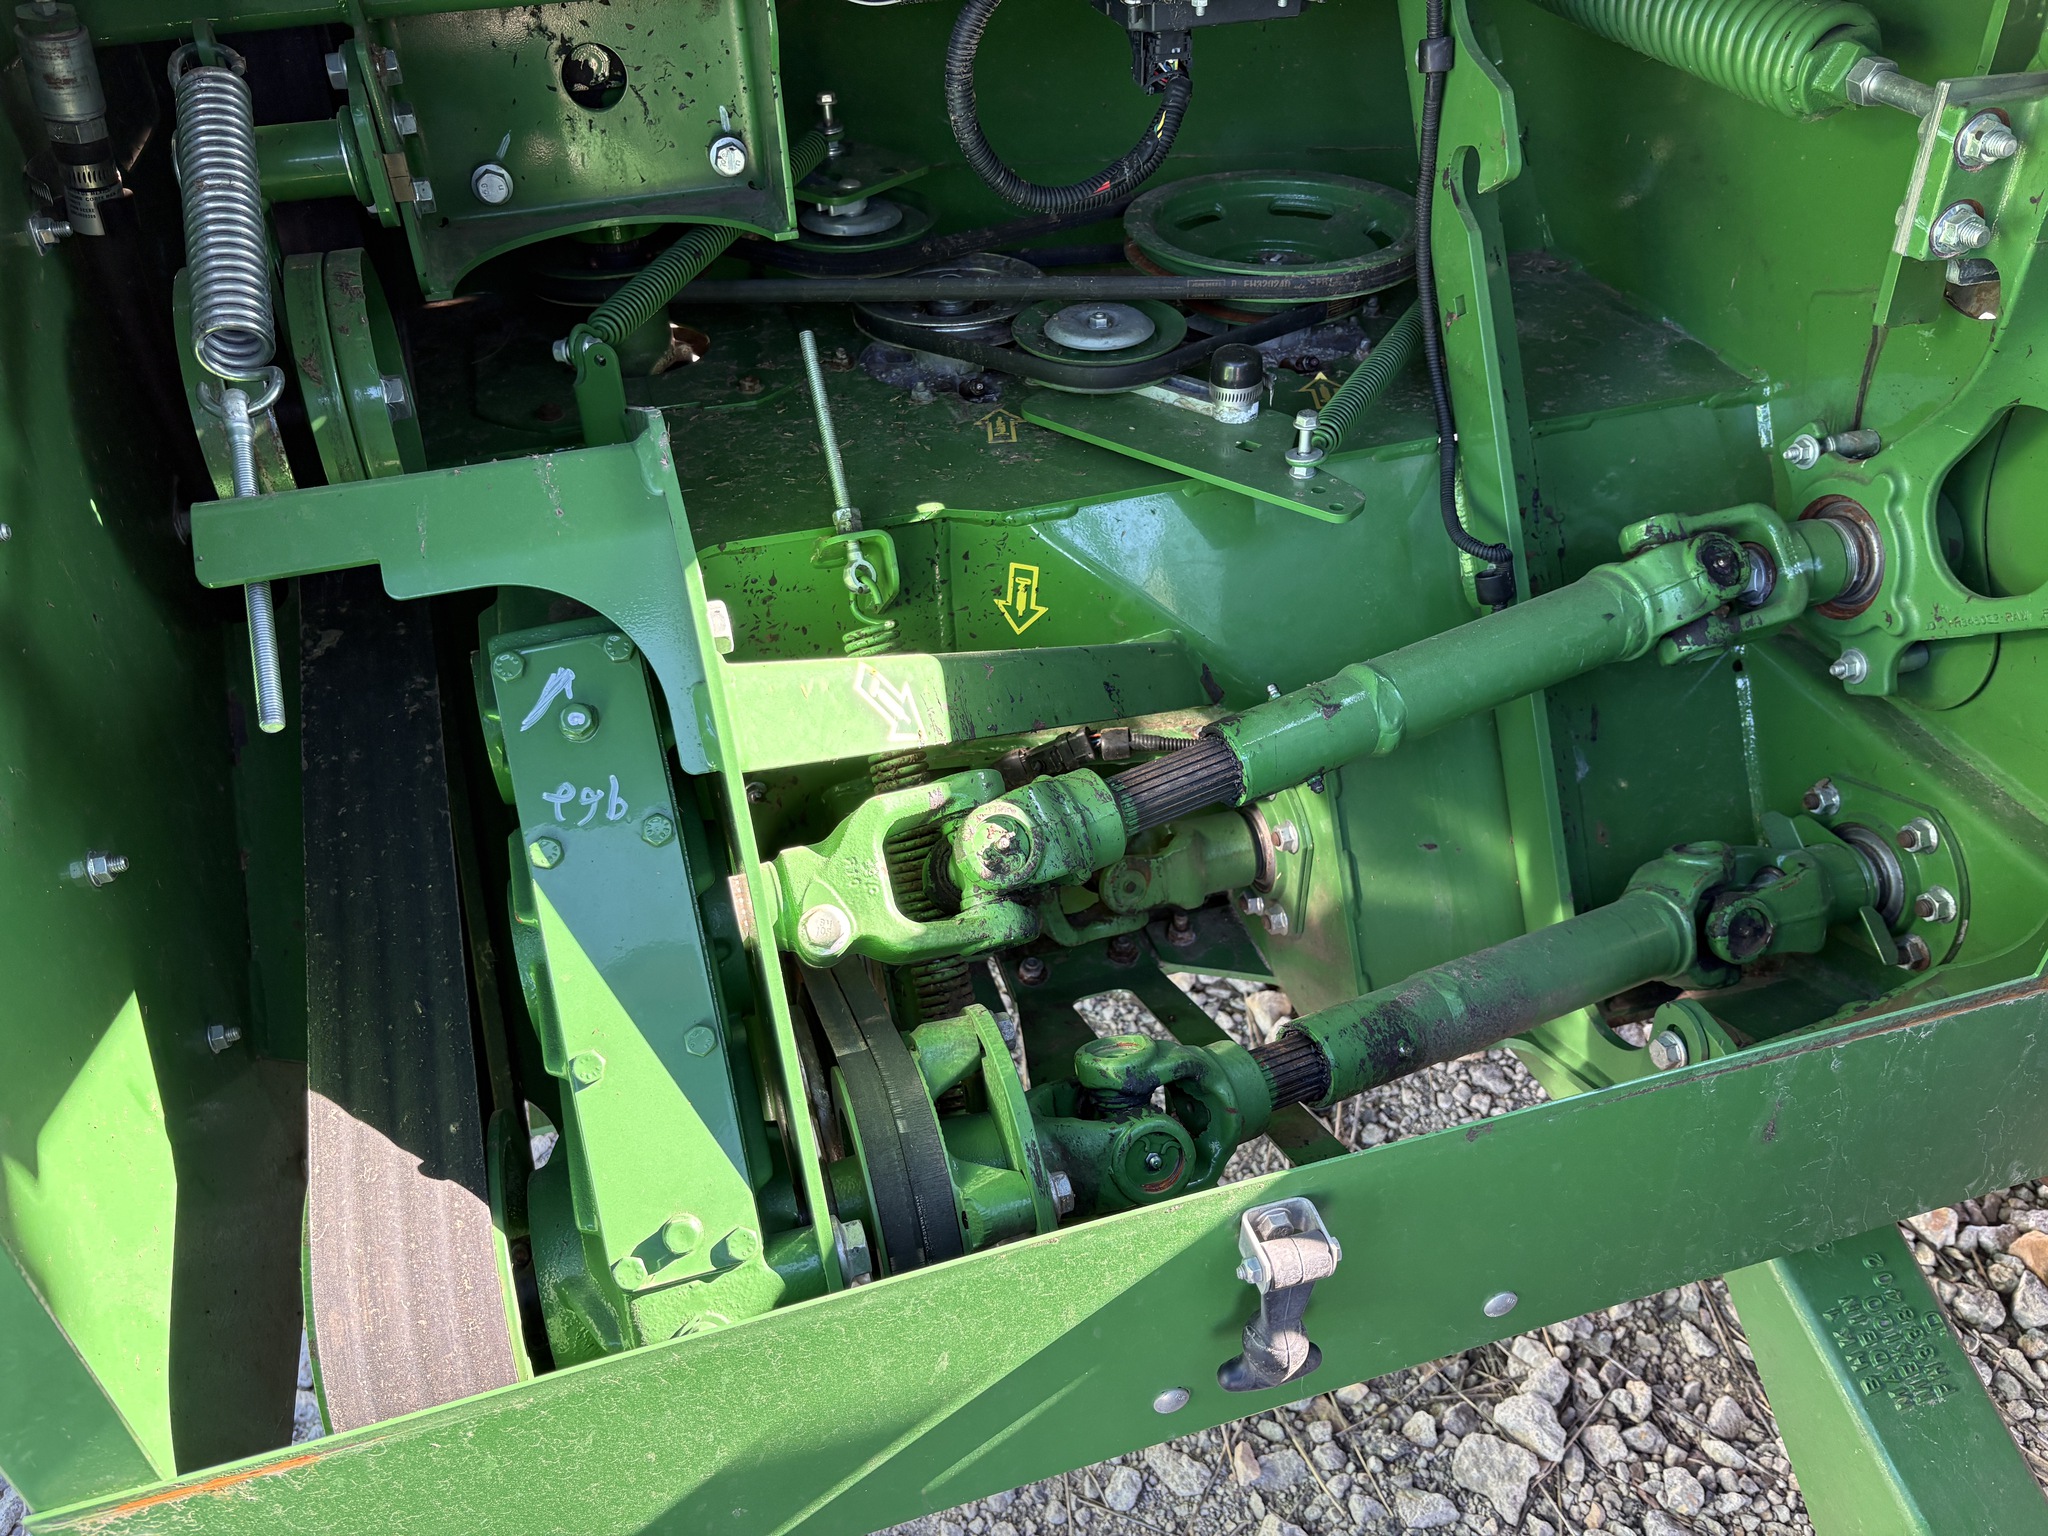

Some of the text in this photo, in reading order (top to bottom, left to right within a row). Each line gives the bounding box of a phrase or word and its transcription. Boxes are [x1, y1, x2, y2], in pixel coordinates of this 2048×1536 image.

[1838, 1296, 1914, 1411] MADE IN
[1861, 1297, 1932, 1405] MEXICO
